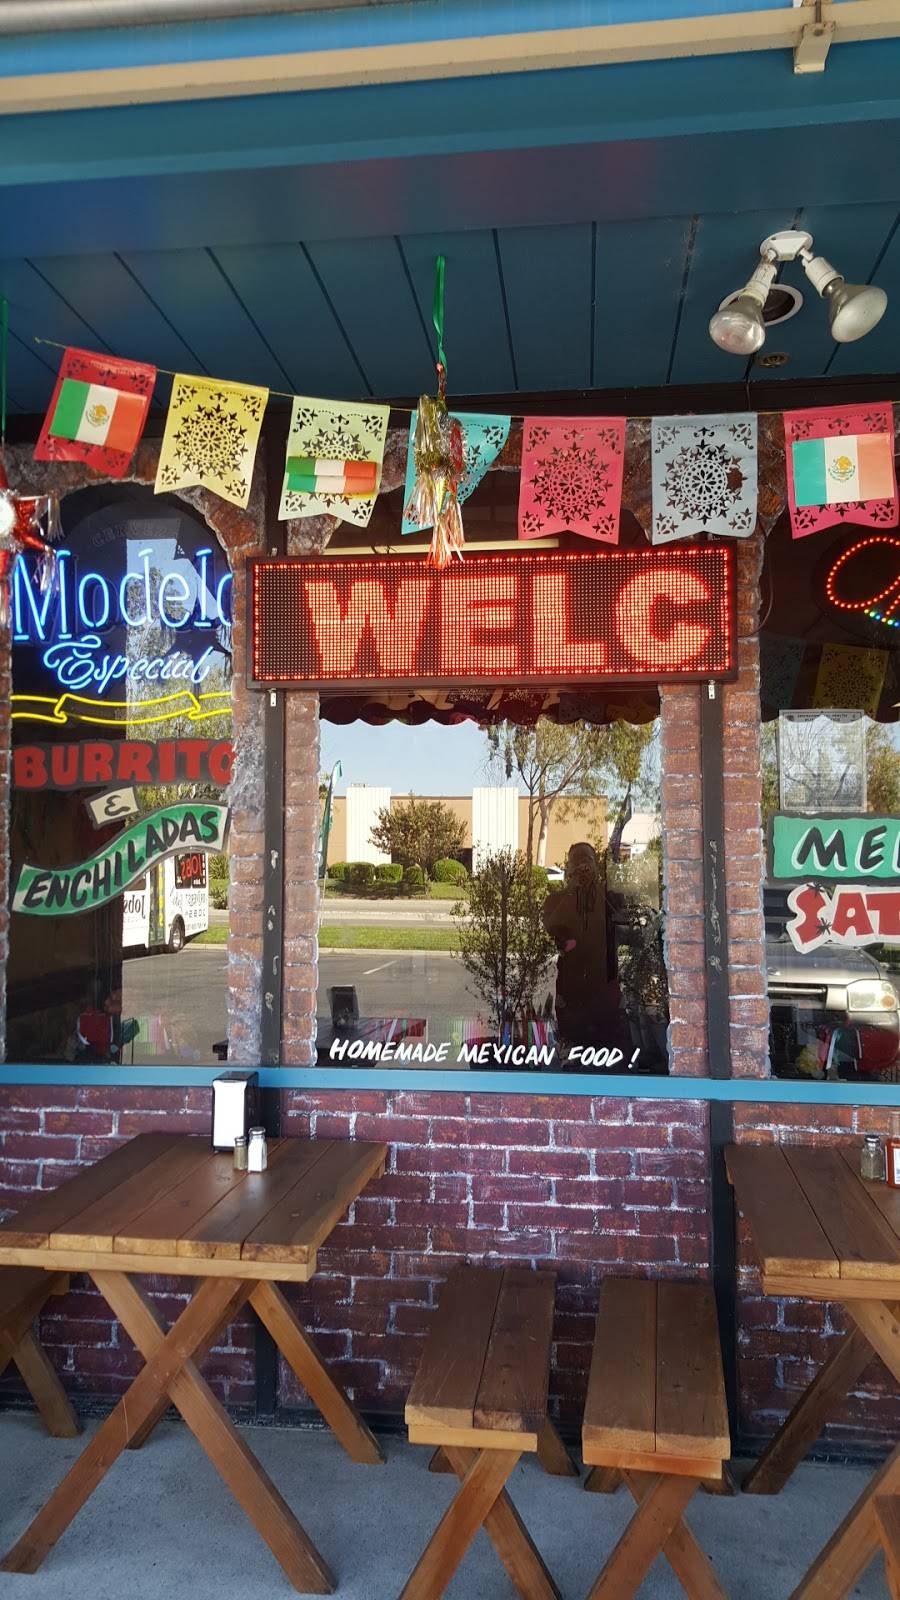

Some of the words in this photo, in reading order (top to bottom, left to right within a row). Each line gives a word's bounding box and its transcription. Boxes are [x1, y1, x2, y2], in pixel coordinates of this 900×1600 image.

[303, 567, 712, 672] WELC
[43, 634, 215, 693] Especial
[22, 810, 220, 907] ENCHILADAS
[792, 825, 900, 873] ME
[329, 1038, 450, 1063] HOMEMADE
[457, 1042, 556, 1066] MEXICAN
